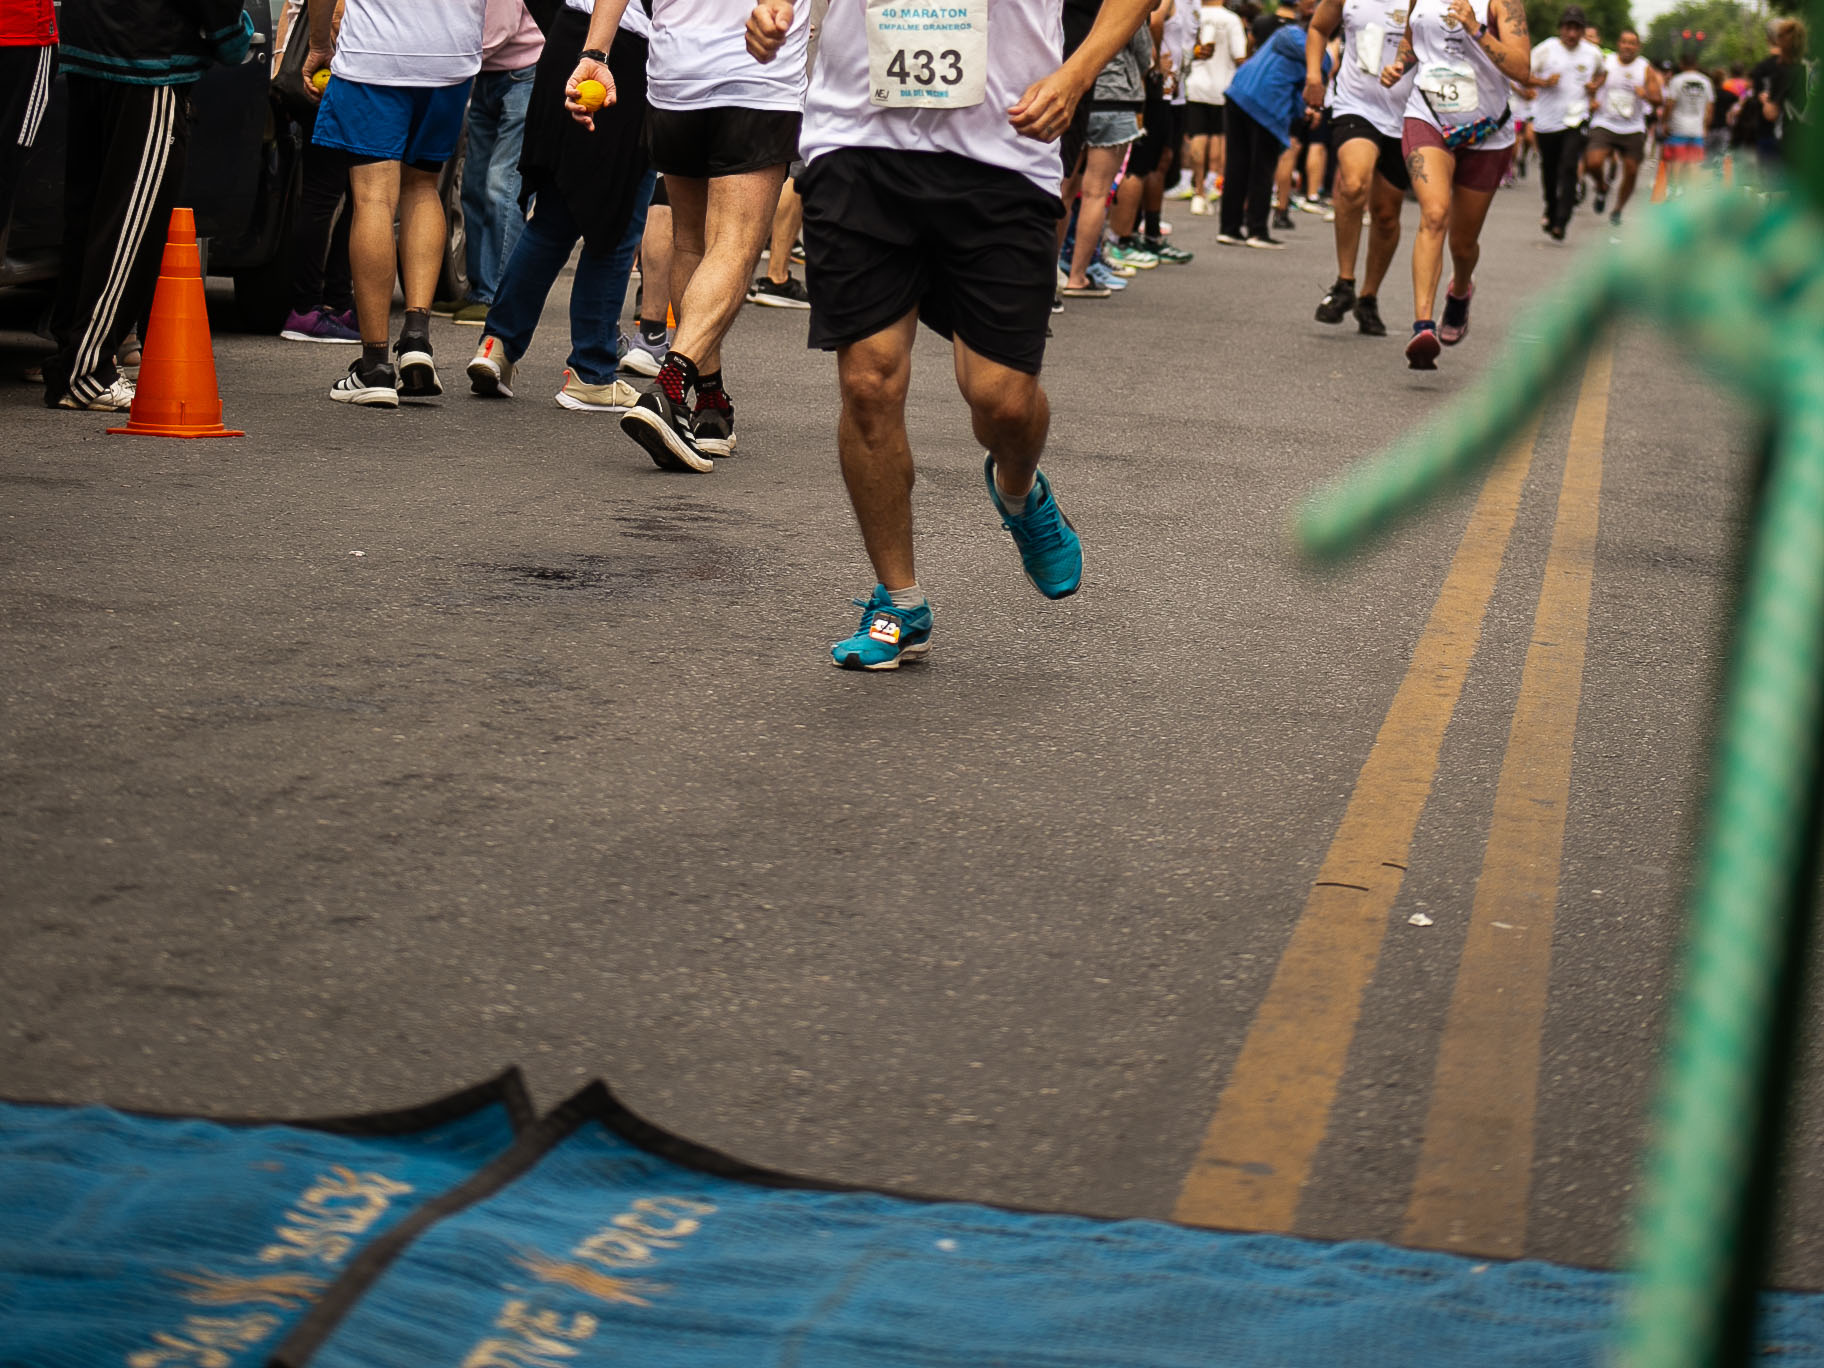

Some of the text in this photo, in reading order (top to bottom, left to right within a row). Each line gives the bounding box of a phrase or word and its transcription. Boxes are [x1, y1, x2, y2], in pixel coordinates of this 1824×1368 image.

[882, 8, 967, 19] 40 MARATON
[879, 22, 972, 31] EMPALME GRANEROS
[886, 49, 964, 86] 433
